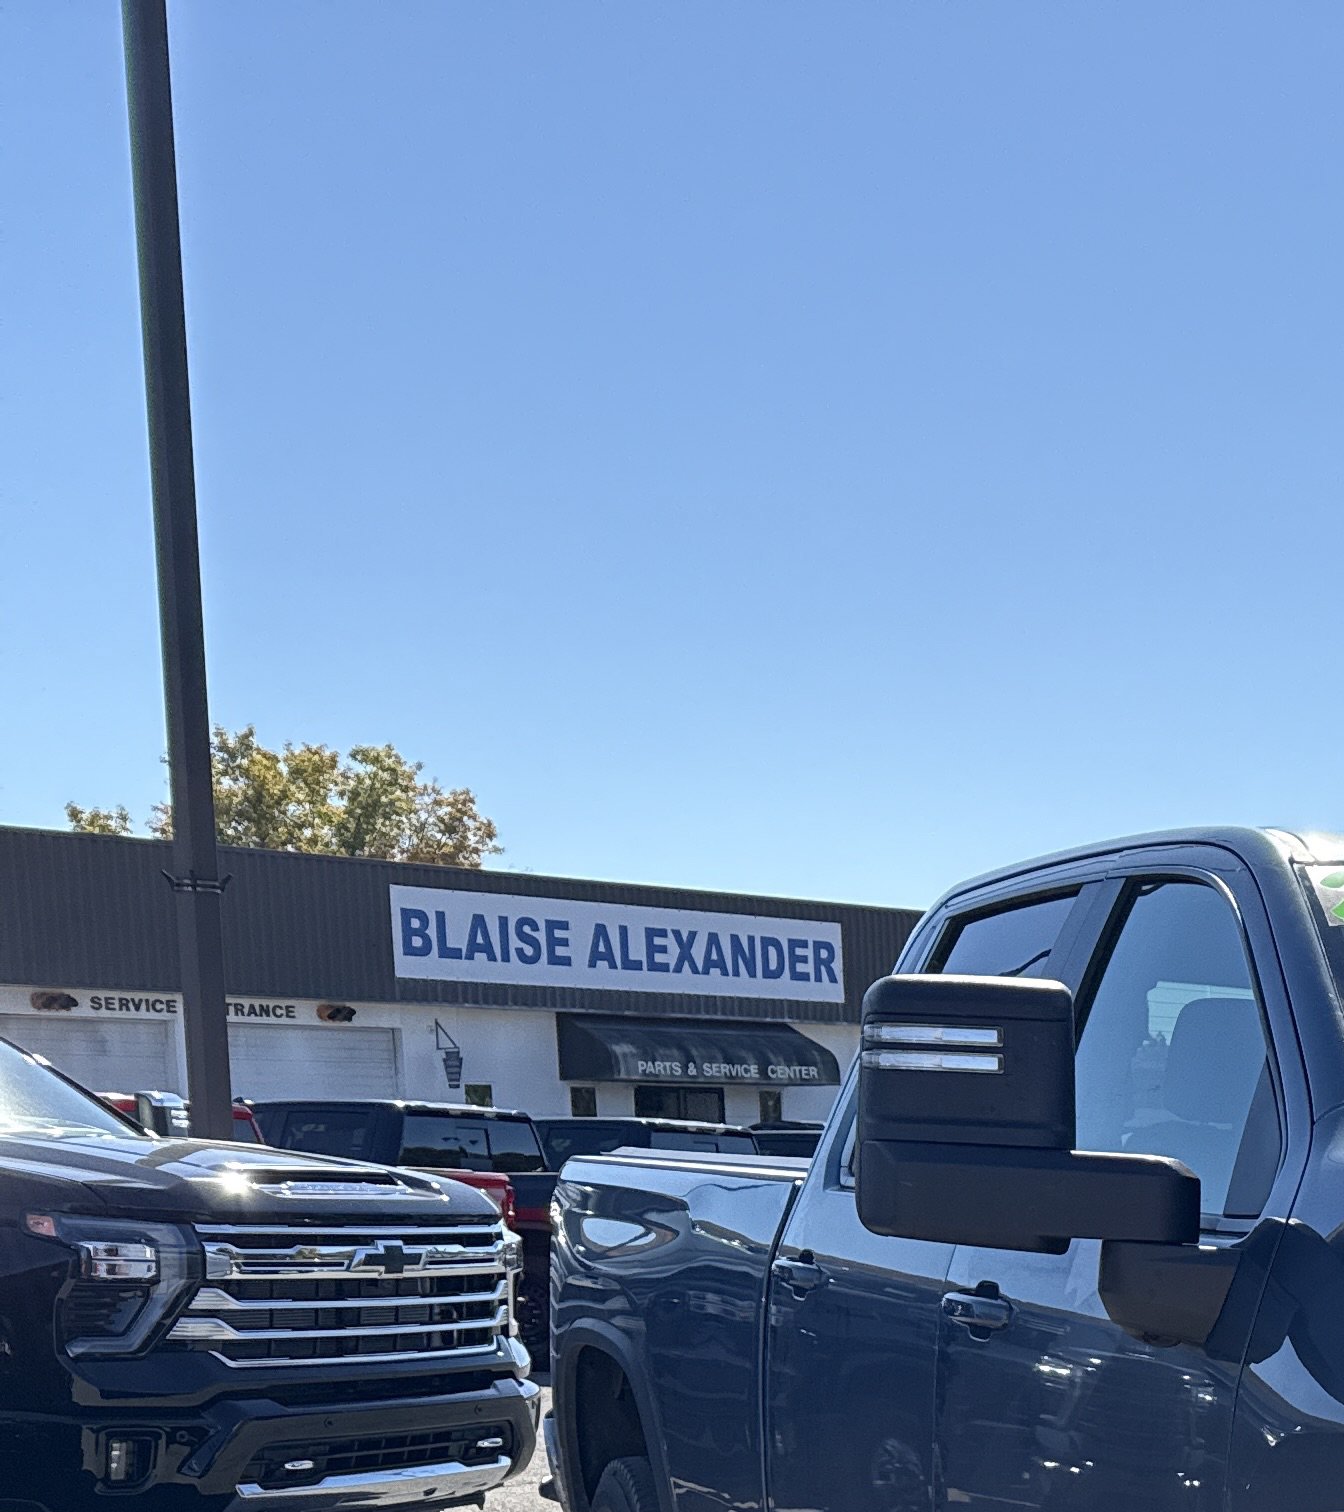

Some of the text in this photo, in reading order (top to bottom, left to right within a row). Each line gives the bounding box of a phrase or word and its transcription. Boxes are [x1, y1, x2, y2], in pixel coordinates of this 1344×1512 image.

[400, 907, 838, 984] BLAISE ALEXANDER
[89, 995, 296, 1019] SERVICE TRANCE
[637, 1060, 819, 1079] PARTS & SERVICE CENTER
